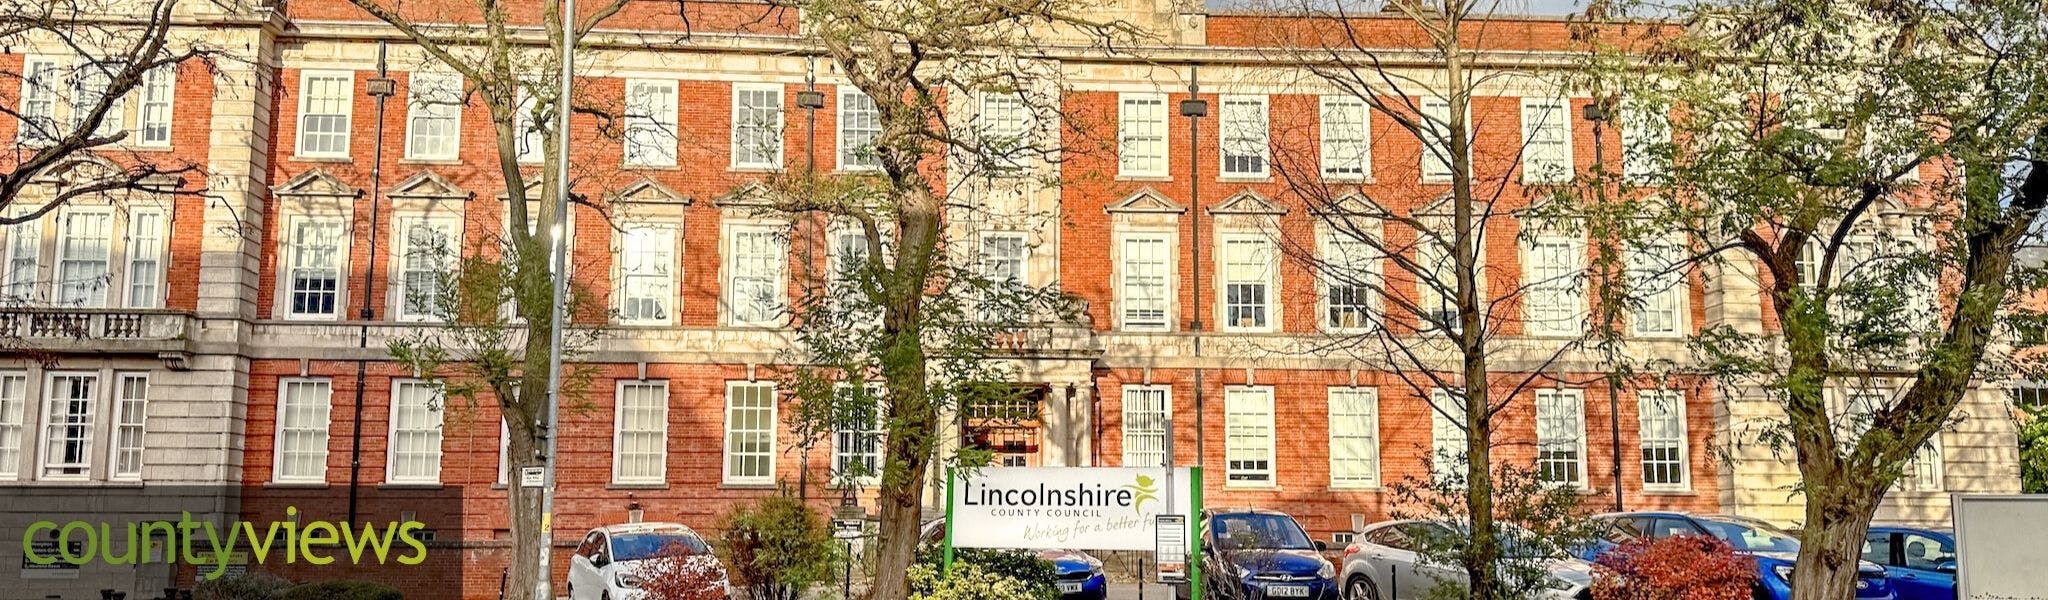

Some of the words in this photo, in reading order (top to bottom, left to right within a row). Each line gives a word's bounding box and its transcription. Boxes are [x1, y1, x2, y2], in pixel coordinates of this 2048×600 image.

[963, 482, 1132, 507] Lincolnshire
[990, 508, 1040, 517] COUNTY
[1046, 508, 1102, 518] COUNCIL
[1023, 524, 1069, 543] Working
[1073, 519, 1090, 539] for
[1094, 523, 1103, 532] a
[1106, 515, 1138, 532] better
